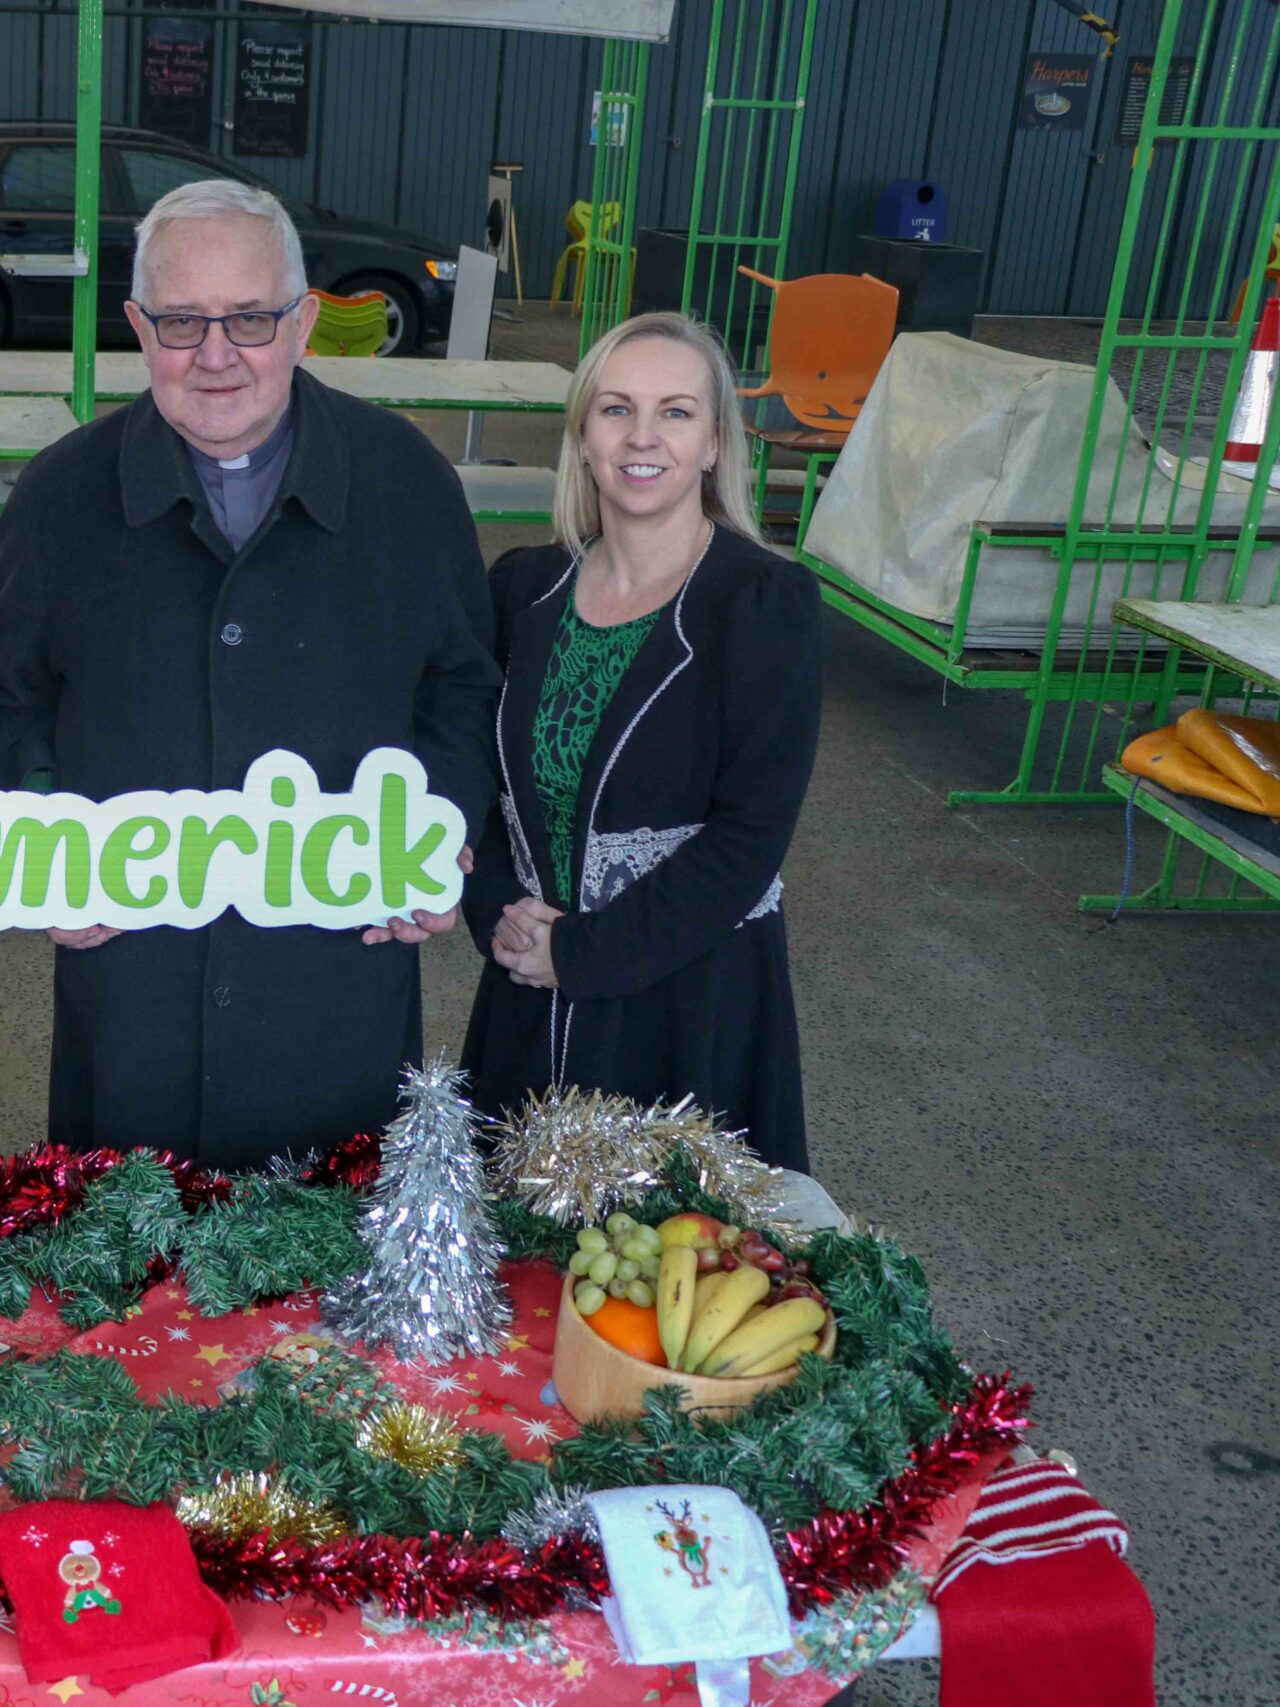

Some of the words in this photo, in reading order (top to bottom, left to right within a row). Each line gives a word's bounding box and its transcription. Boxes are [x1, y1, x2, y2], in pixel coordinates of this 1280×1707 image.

[242, 38, 274, 54] Please
[1031, 60, 1089, 87] Harpers
[911, 218, 936, 227] LITTER
